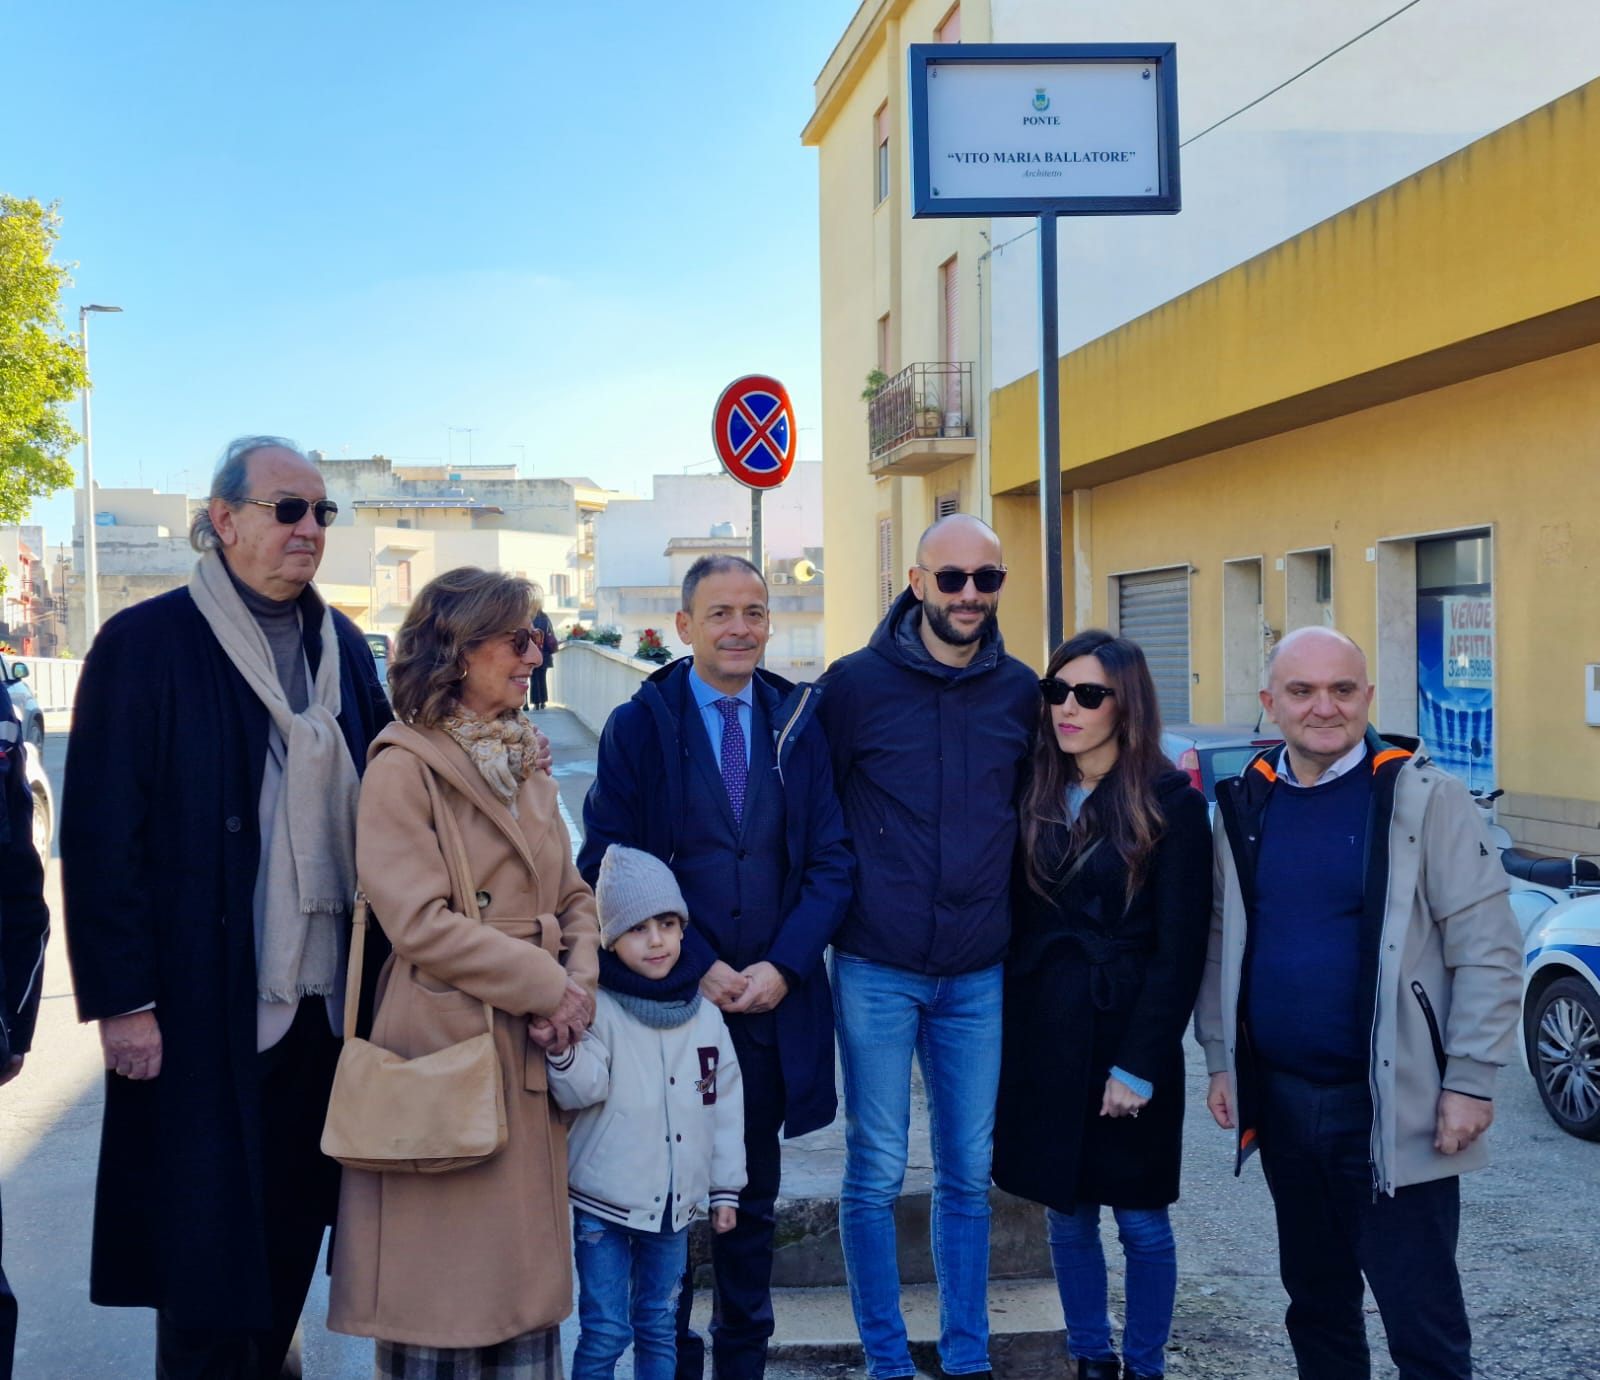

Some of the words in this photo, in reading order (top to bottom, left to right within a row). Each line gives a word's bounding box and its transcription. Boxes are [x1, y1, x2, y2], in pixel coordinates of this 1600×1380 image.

[1023, 116, 1060, 126] PONTE
[993, 152, 1041, 164] MARIA
[1023, 169, 1063, 178] Architetto
[1450, 602, 1492, 629] VENDE
